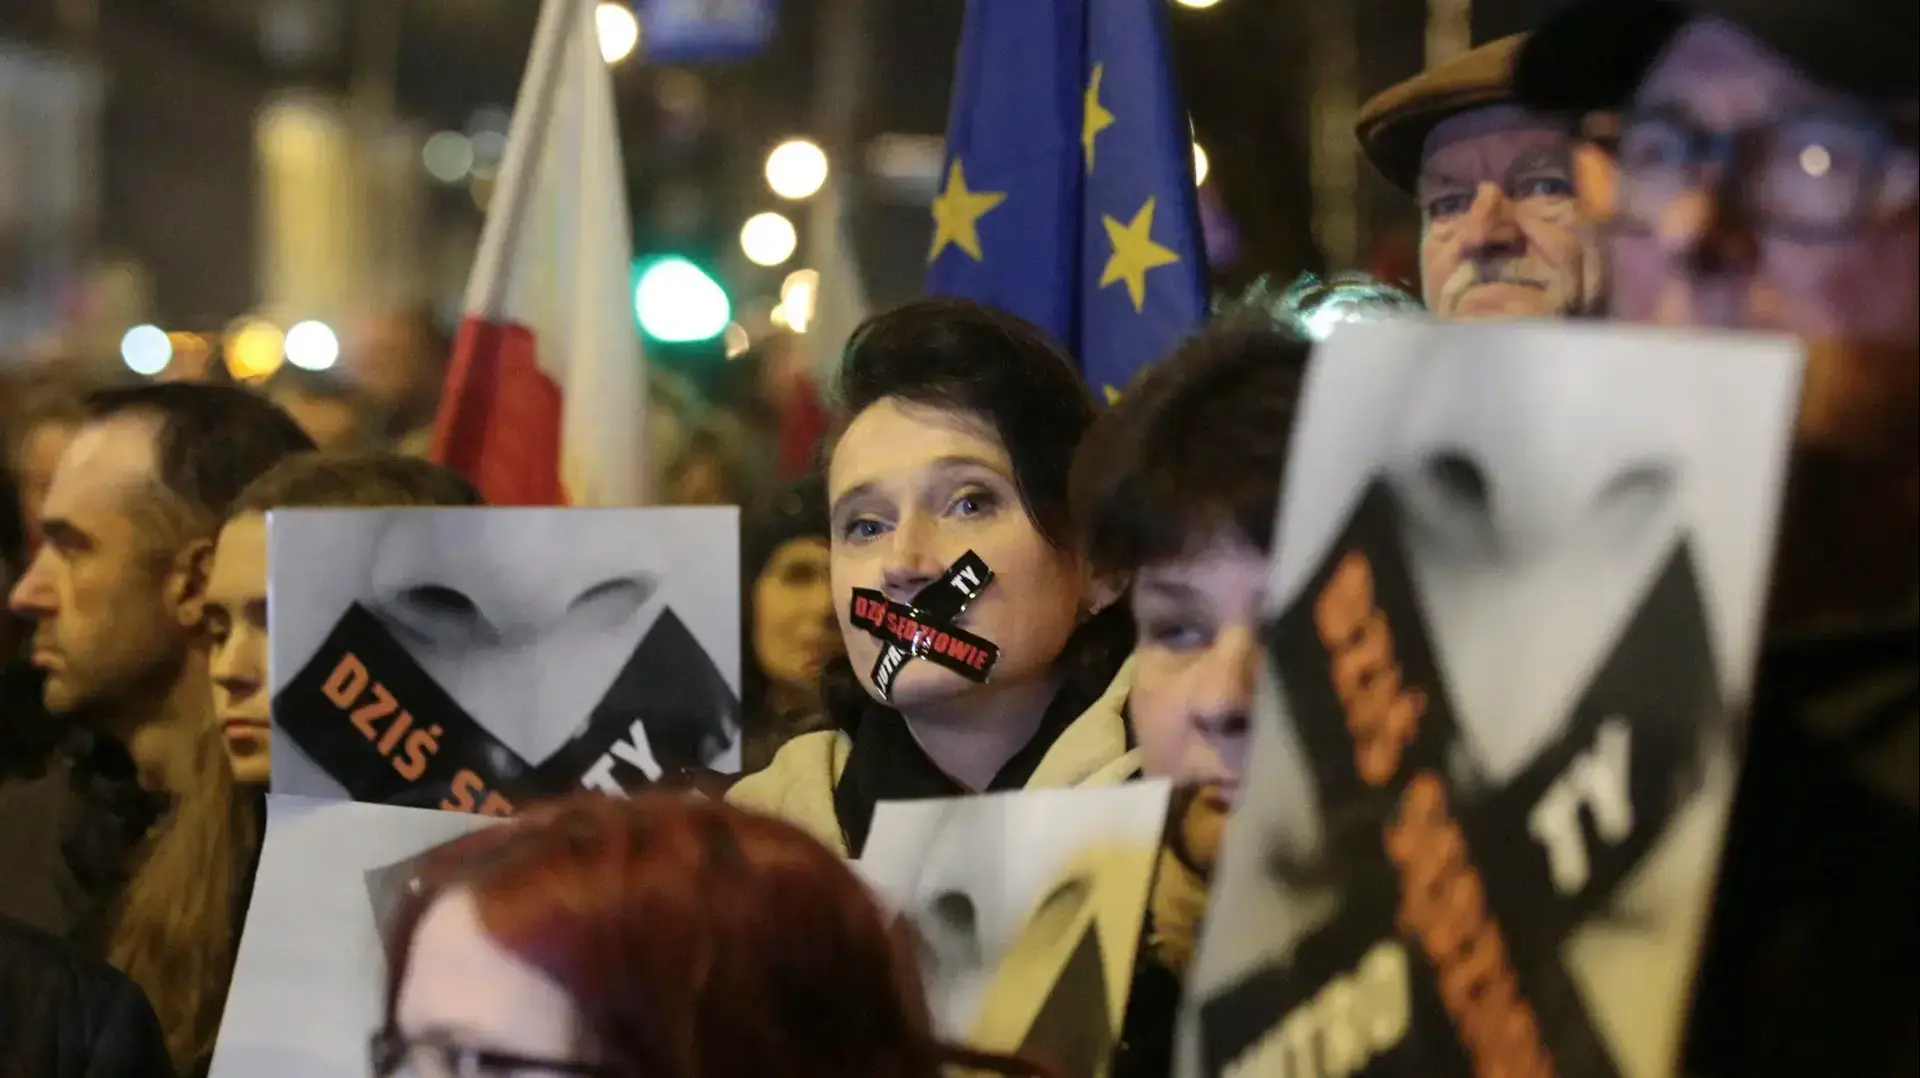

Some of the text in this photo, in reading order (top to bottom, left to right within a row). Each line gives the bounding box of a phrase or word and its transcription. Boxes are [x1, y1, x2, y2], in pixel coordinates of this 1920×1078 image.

[950, 565, 980, 594] TY
[321, 652, 443, 781] DZIŚ
[581, 718, 662, 801] TY
[1528, 717, 1632, 895] TY
